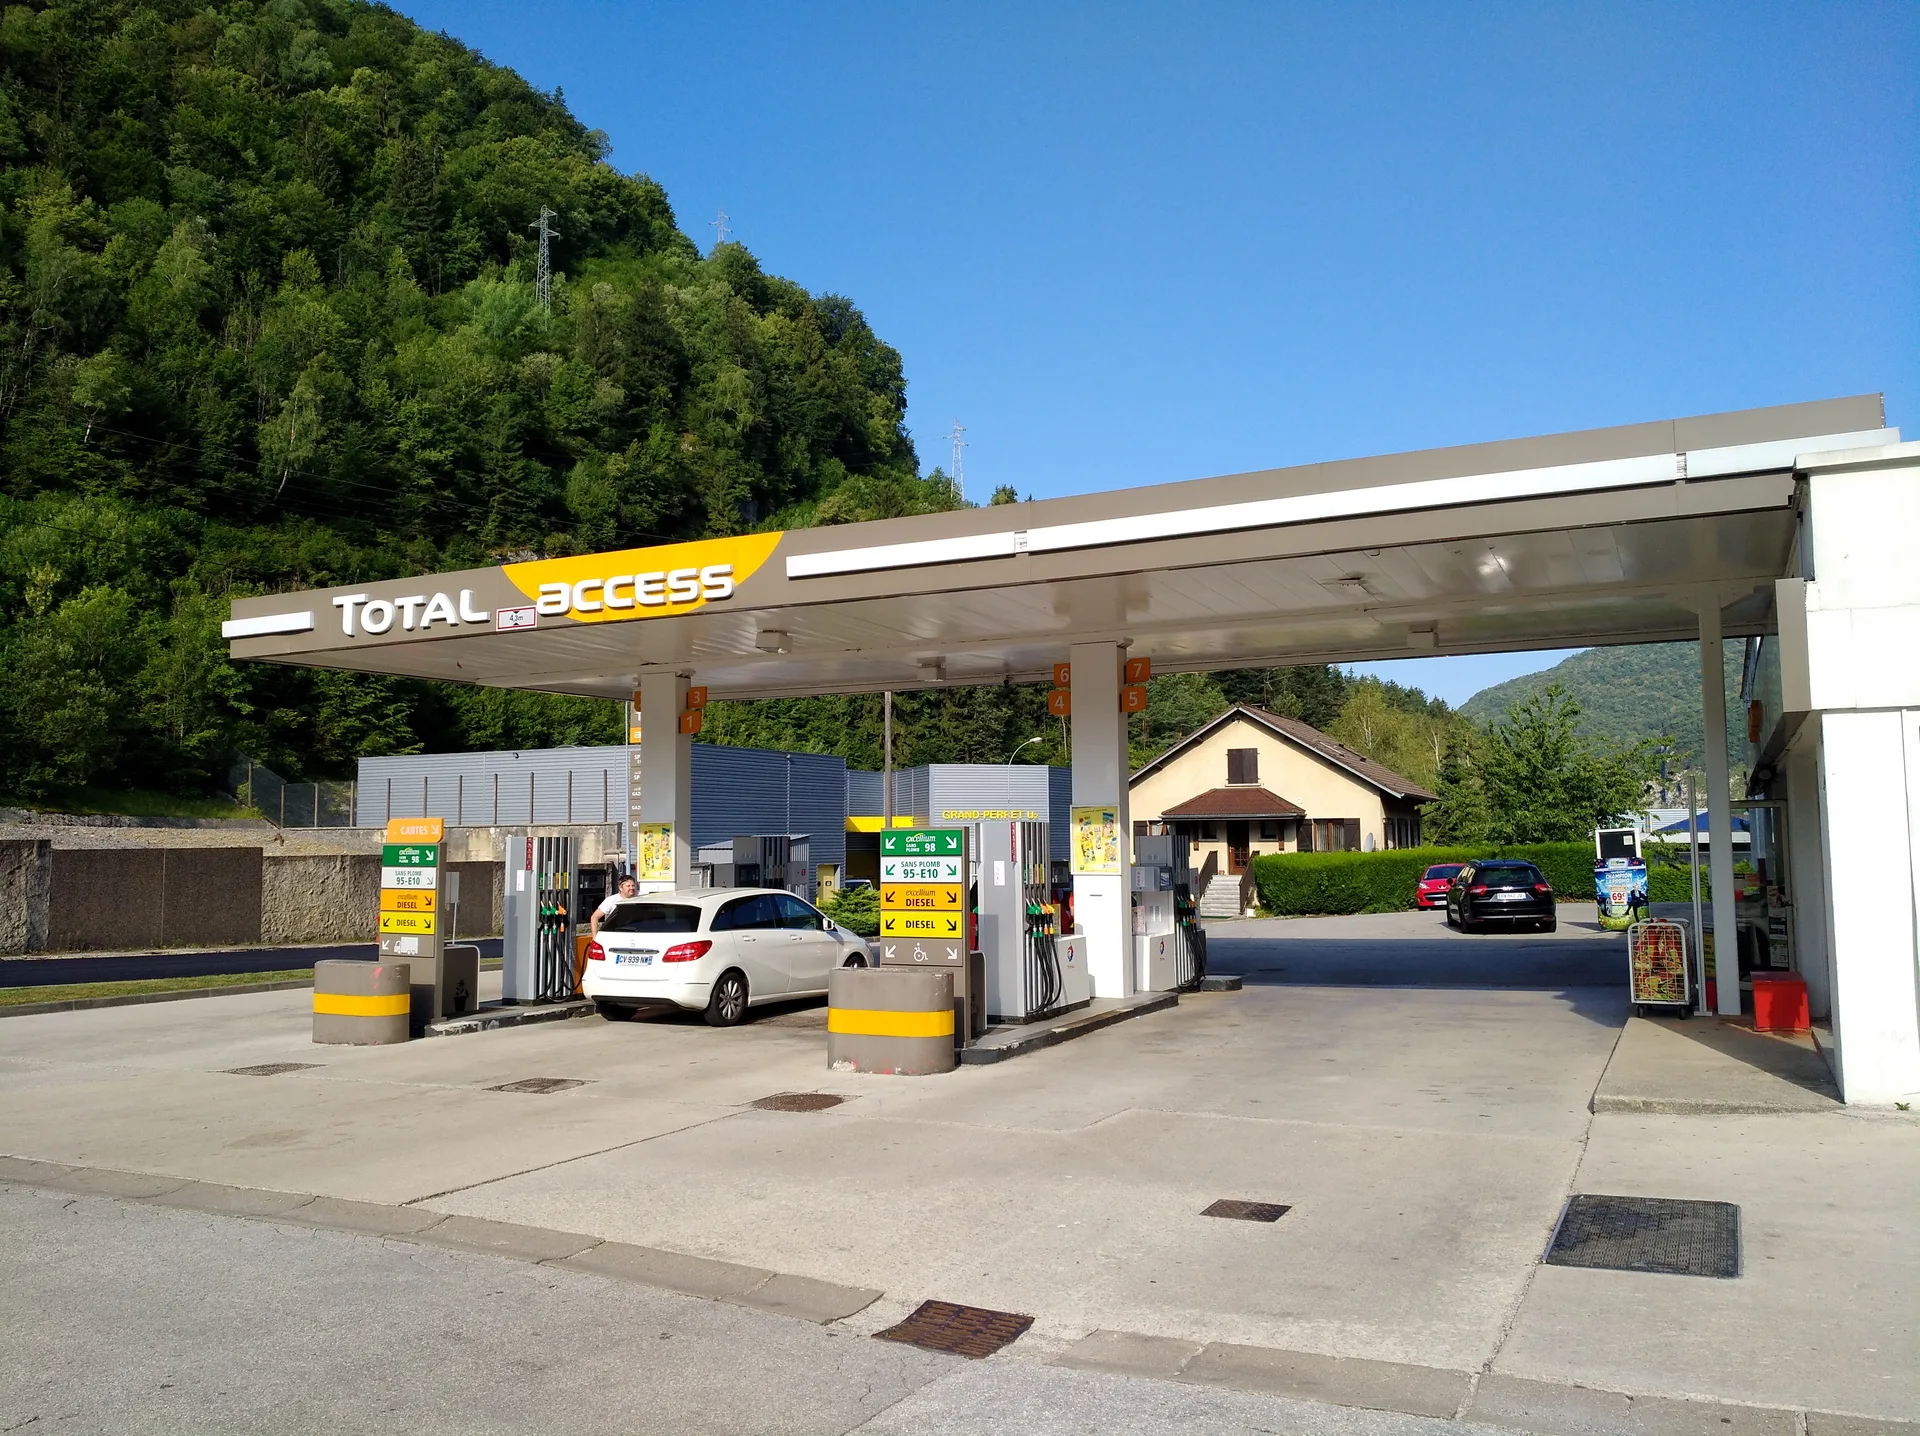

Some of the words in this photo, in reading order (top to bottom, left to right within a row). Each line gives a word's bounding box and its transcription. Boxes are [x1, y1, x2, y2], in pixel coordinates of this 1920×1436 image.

[333, 589, 491, 637] TOTAL
[1060, 668, 1070, 682] 6
[1133, 663, 1142, 678] 7
[693, 691, 700, 704] 3
[1054, 695, 1064, 709] 4
[1128, 691, 1138, 706] 5
[686, 715, 693, 729] 1
[400, 825, 429, 835] CARTES
[924, 843, 936, 852] 98
[411, 855, 420, 864] 98
[903, 869, 938, 879] 95-E10
[396, 877, 421, 886] 95-E10
[905, 888, 936, 897] excellium
[396, 901, 418, 909] DIESEL
[905, 898, 935, 907] DIESEL
[396, 919, 417, 927] DIESEL
[905, 920, 935, 929] DIESEL
